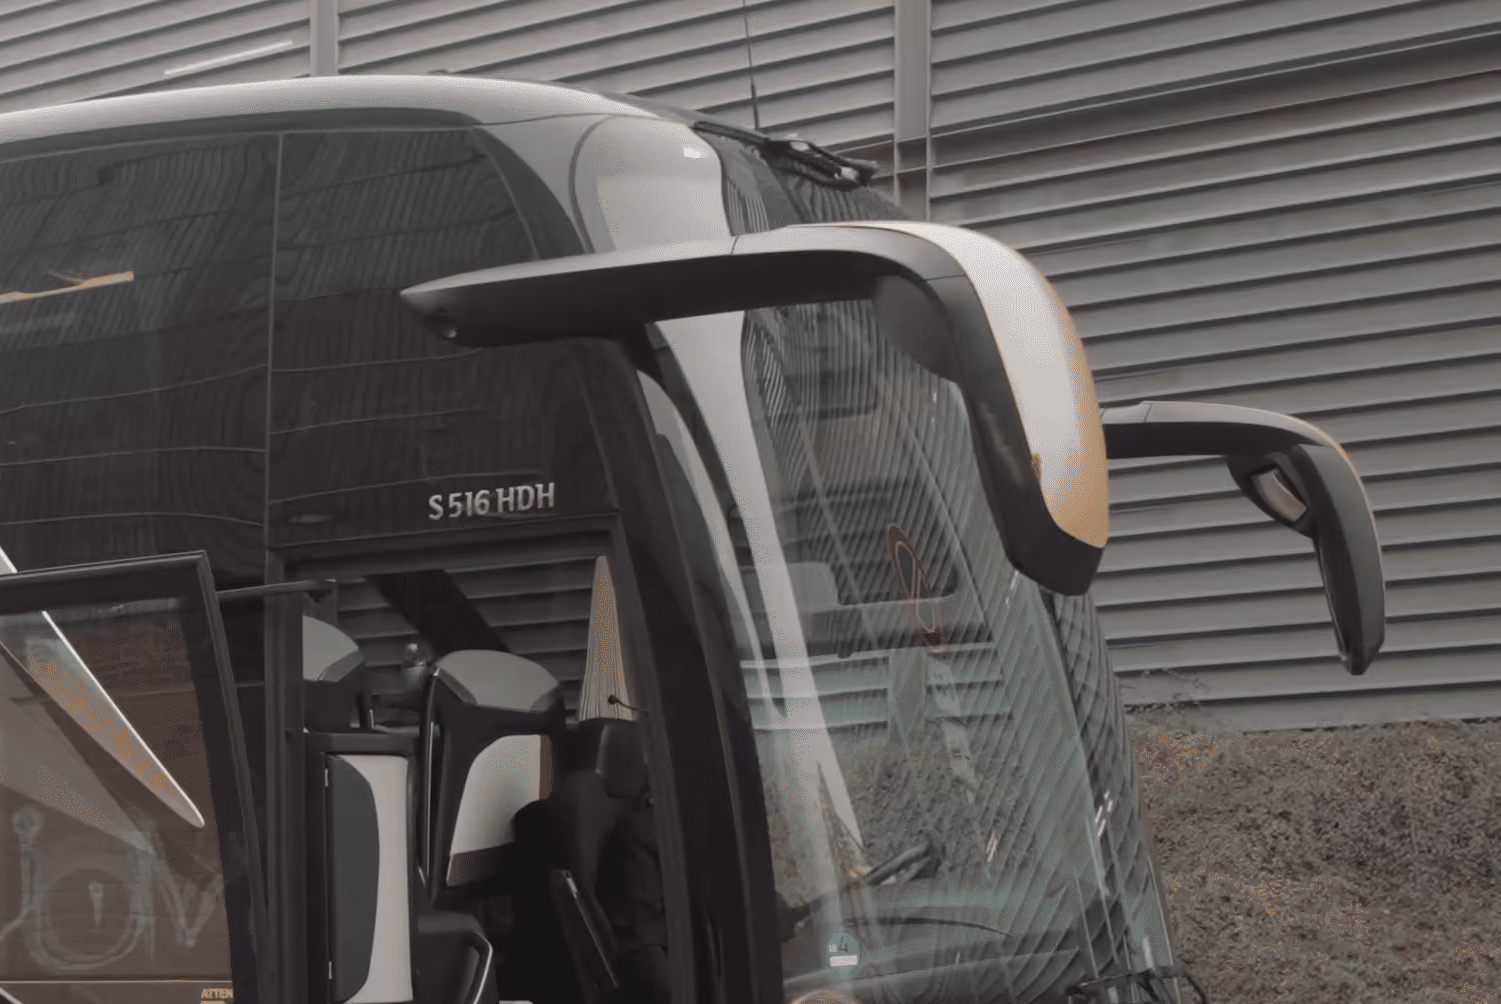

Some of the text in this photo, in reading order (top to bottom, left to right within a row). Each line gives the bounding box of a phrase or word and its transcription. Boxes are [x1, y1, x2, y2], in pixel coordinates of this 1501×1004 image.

[428, 482, 555, 520] S 516 HDH
[200, 988, 235, 999] ATTEN
